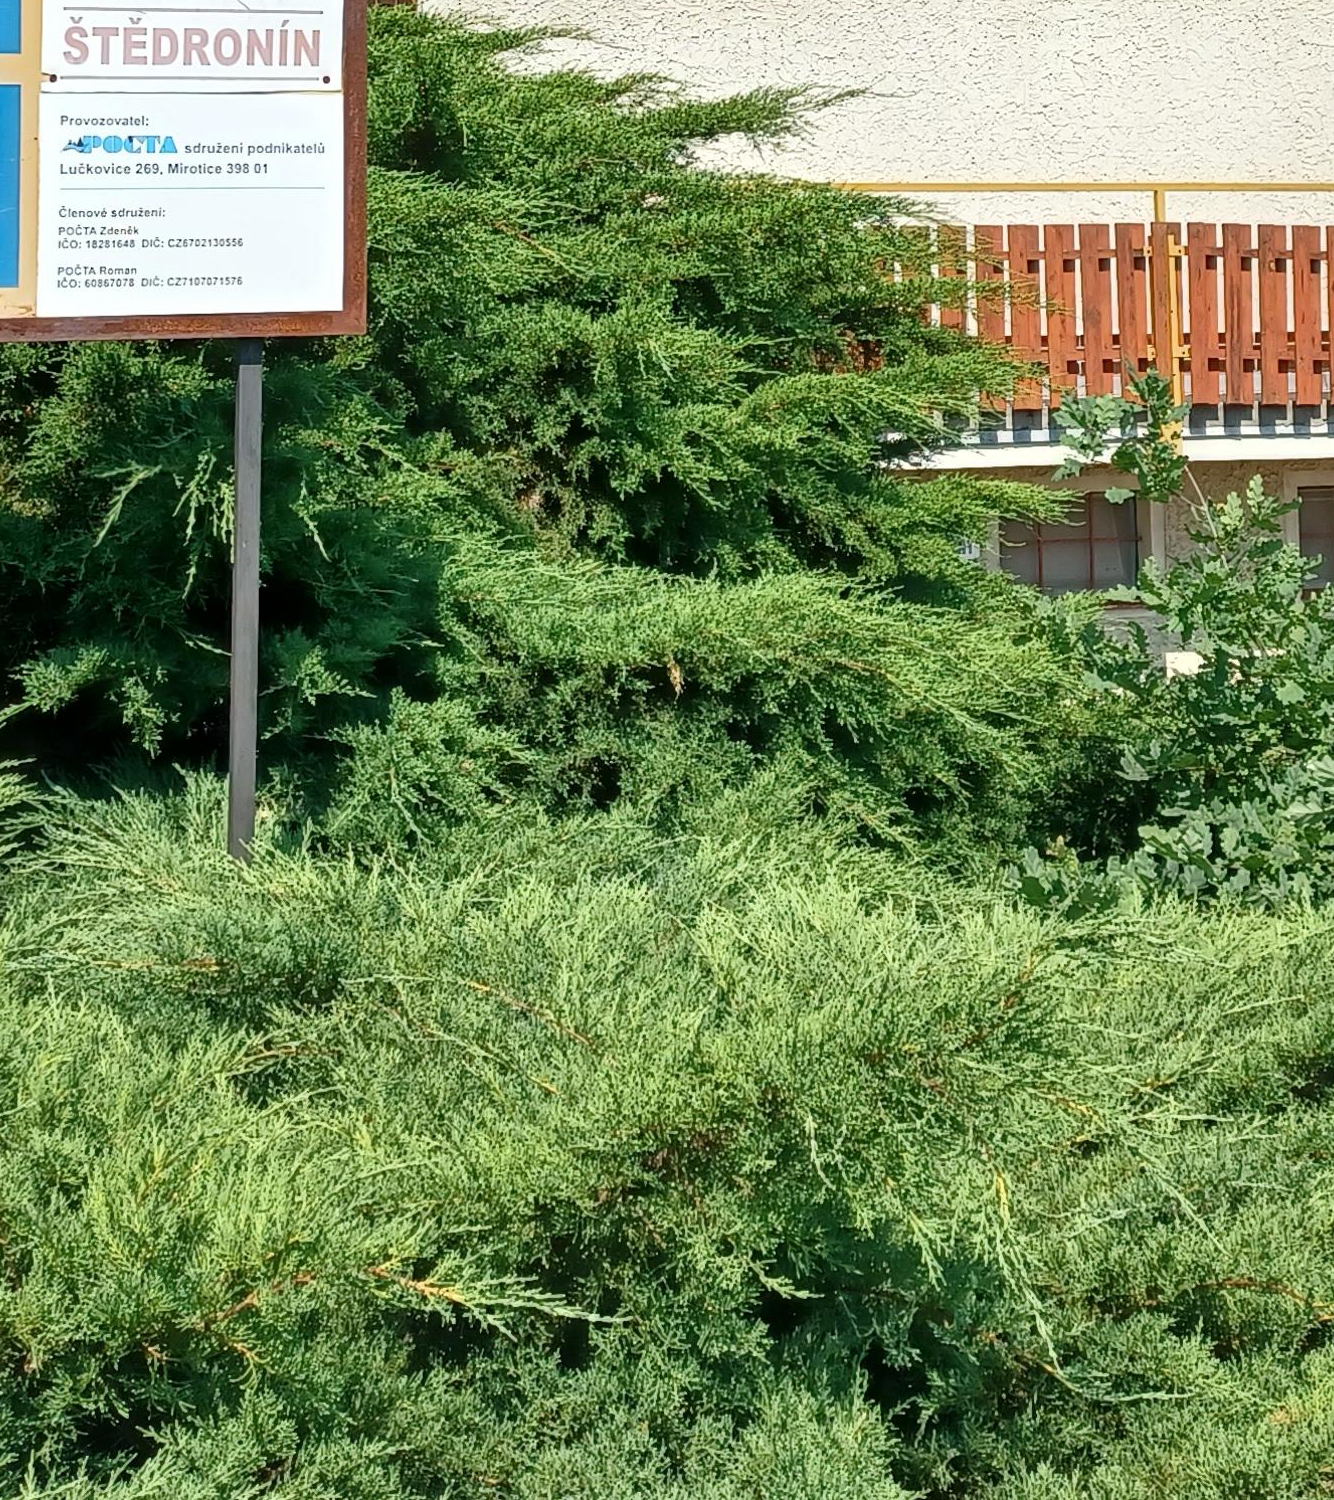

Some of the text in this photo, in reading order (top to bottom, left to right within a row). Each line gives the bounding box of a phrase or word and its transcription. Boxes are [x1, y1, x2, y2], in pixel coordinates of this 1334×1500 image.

[63, 17, 320, 66] ŠTĚDRONÍN
[60, 115, 149, 127] Provozovatel:
[81, 135, 325, 157] POČTA sdružení podnikatelů
[59, 162, 131, 175] Lučkovice
[167, 162, 223, 175] Mirotice
[226, 162, 250, 175] 398
[253, 163, 268, 174] 01
[58, 205, 166, 218] Členové sdružení:
[58, 224, 139, 236] POČTA Zdeněk
[57, 236, 244, 250] IČO: 18281648 DIČ: CZ6702130556
[57, 264, 137, 276] POČTA Roman
[56, 275, 244, 289] IČO: 60867078 DIČ: CZ7107071576
